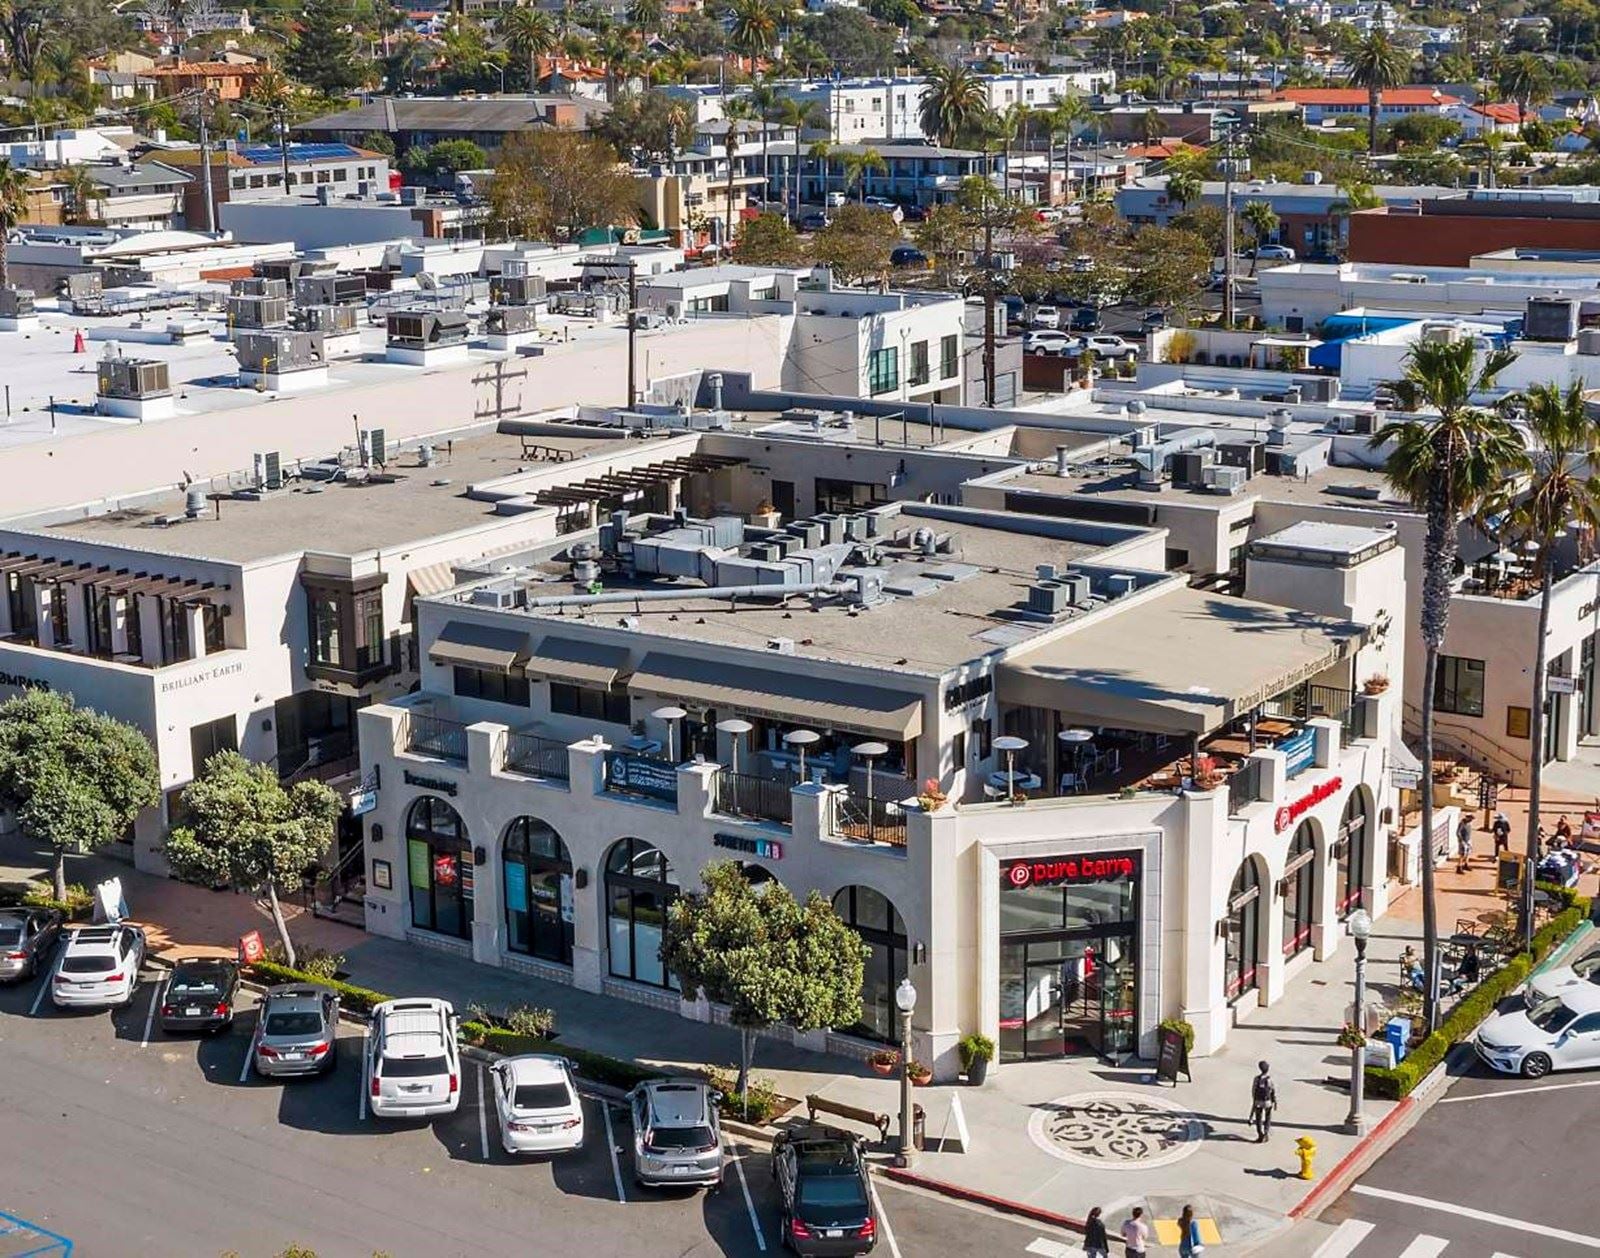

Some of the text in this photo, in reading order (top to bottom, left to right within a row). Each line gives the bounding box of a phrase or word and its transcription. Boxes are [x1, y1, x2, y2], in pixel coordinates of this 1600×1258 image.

[162, 662, 242, 692] BRILLIANT EARTH
[1034, 861, 1078, 882] pure
[1081, 857, 1133, 877] barre
